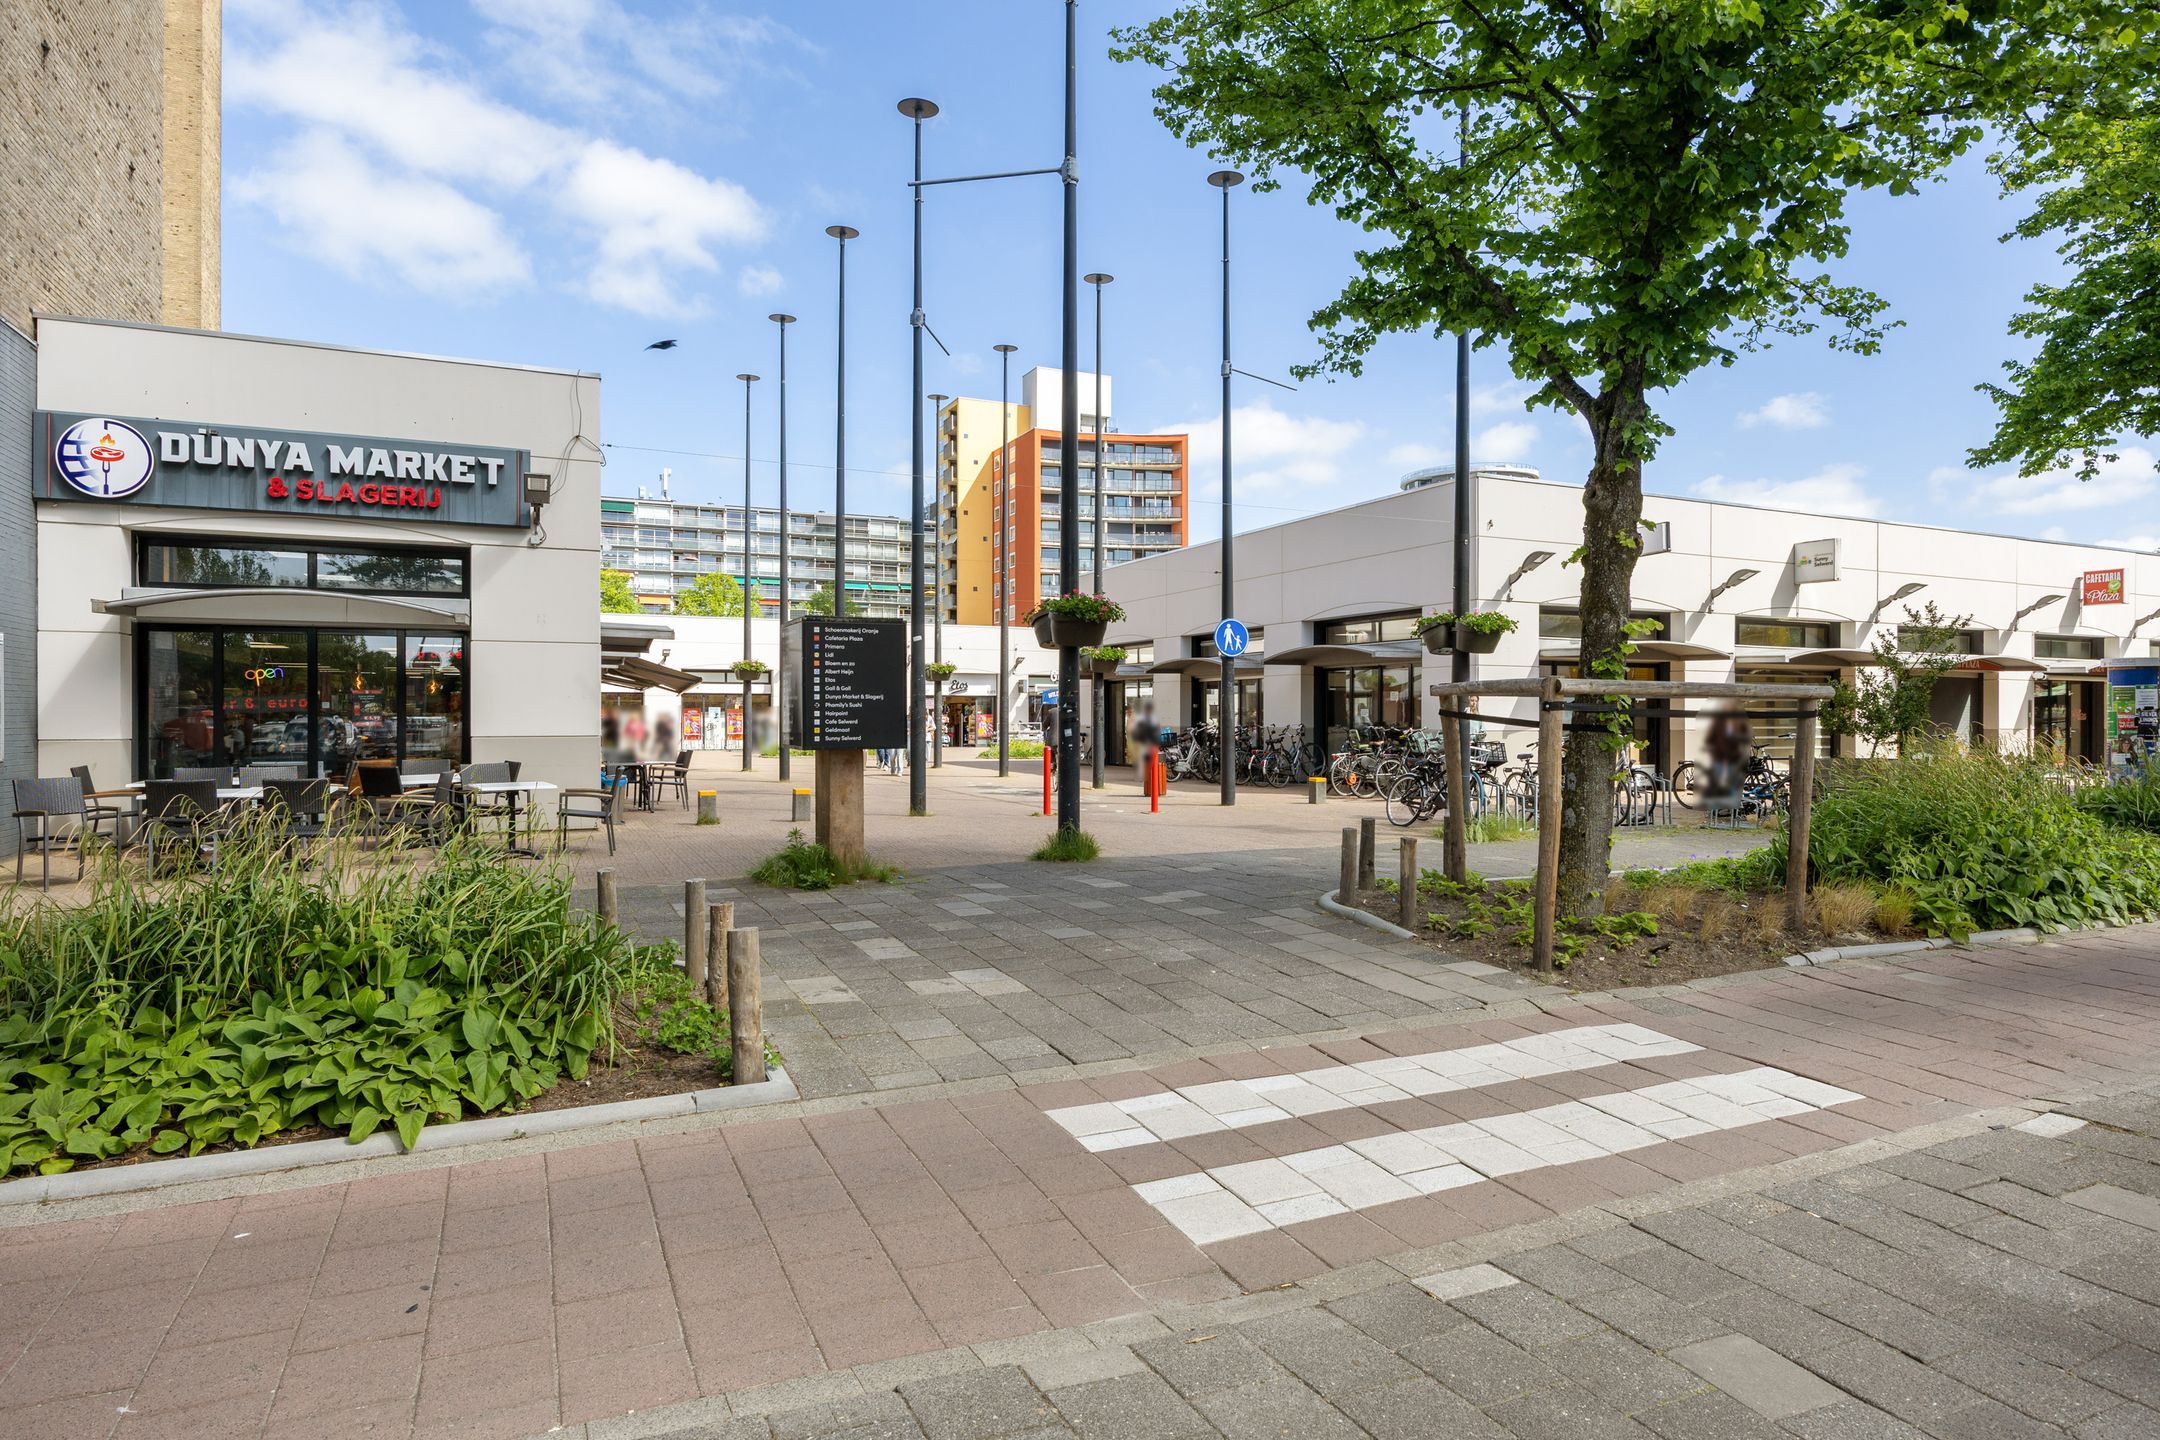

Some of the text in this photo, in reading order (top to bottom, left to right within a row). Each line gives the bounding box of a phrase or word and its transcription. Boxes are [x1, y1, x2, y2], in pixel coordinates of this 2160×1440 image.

[157, 428, 505, 486] DÜNYA MARKET
[268, 476, 442, 509] & SLAGERIJ
[2086, 571, 2121, 584] CAFETARIA
[2085, 589, 2121, 603] Plaza
[244, 668, 284, 687] open
[950, 680, 969, 694] Etos
[824, 735, 840, 743] Sunny
